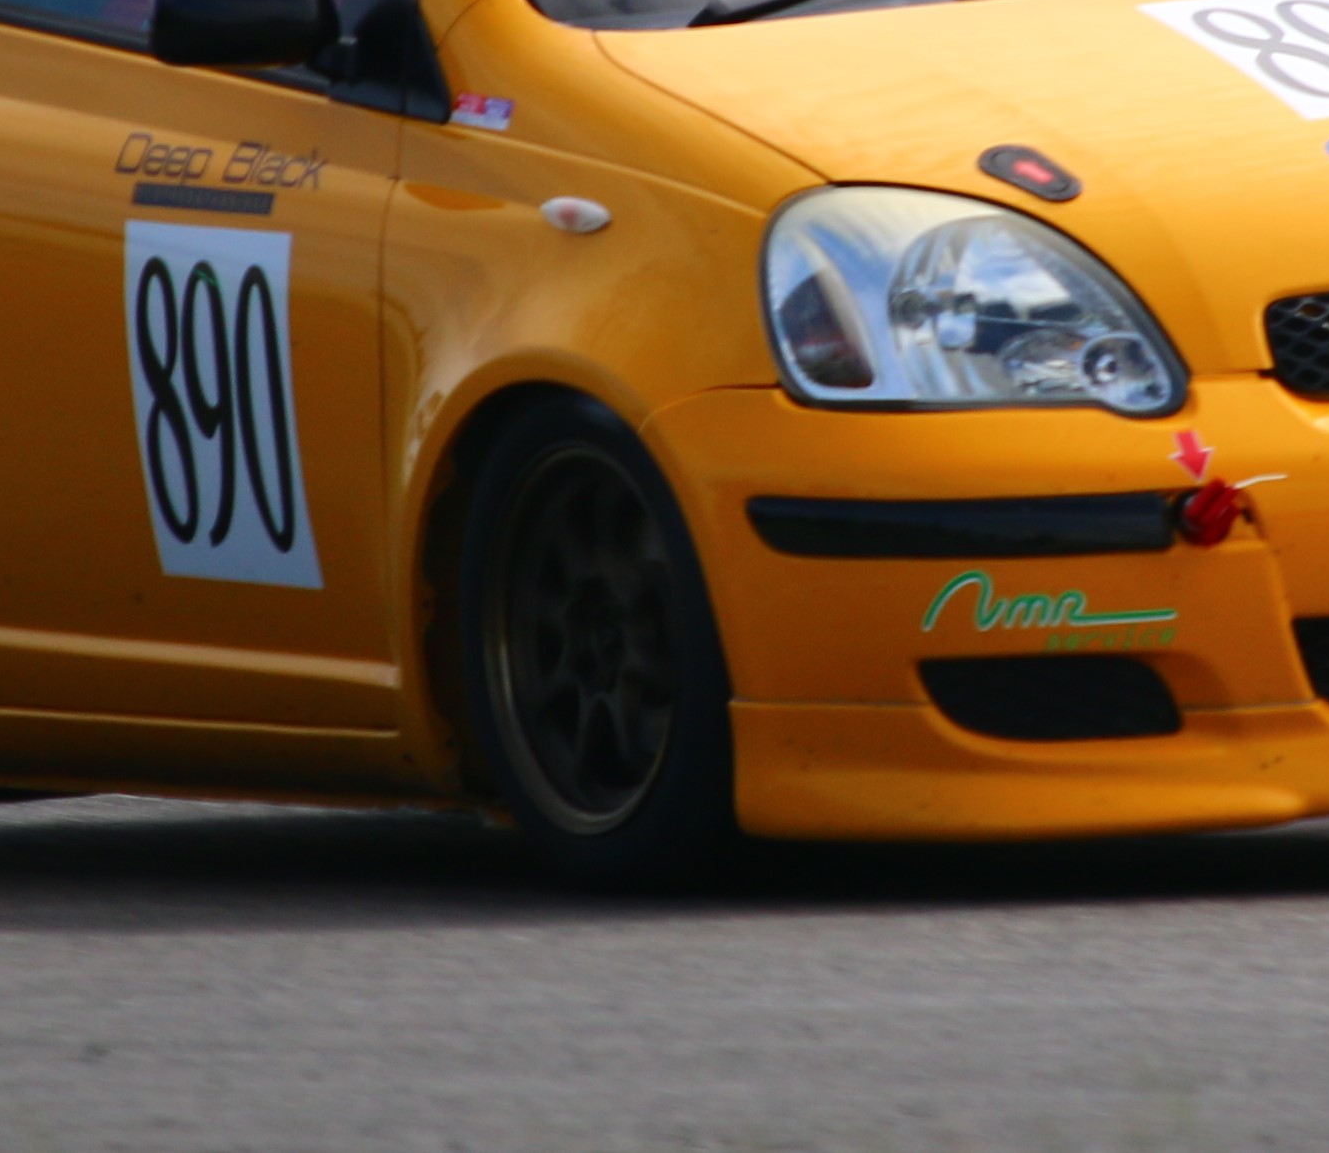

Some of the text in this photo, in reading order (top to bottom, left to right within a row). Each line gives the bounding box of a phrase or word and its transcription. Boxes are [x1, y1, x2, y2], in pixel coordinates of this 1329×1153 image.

[115, 132, 328, 191] Deep Black
[136, 256, 295, 553] 890
